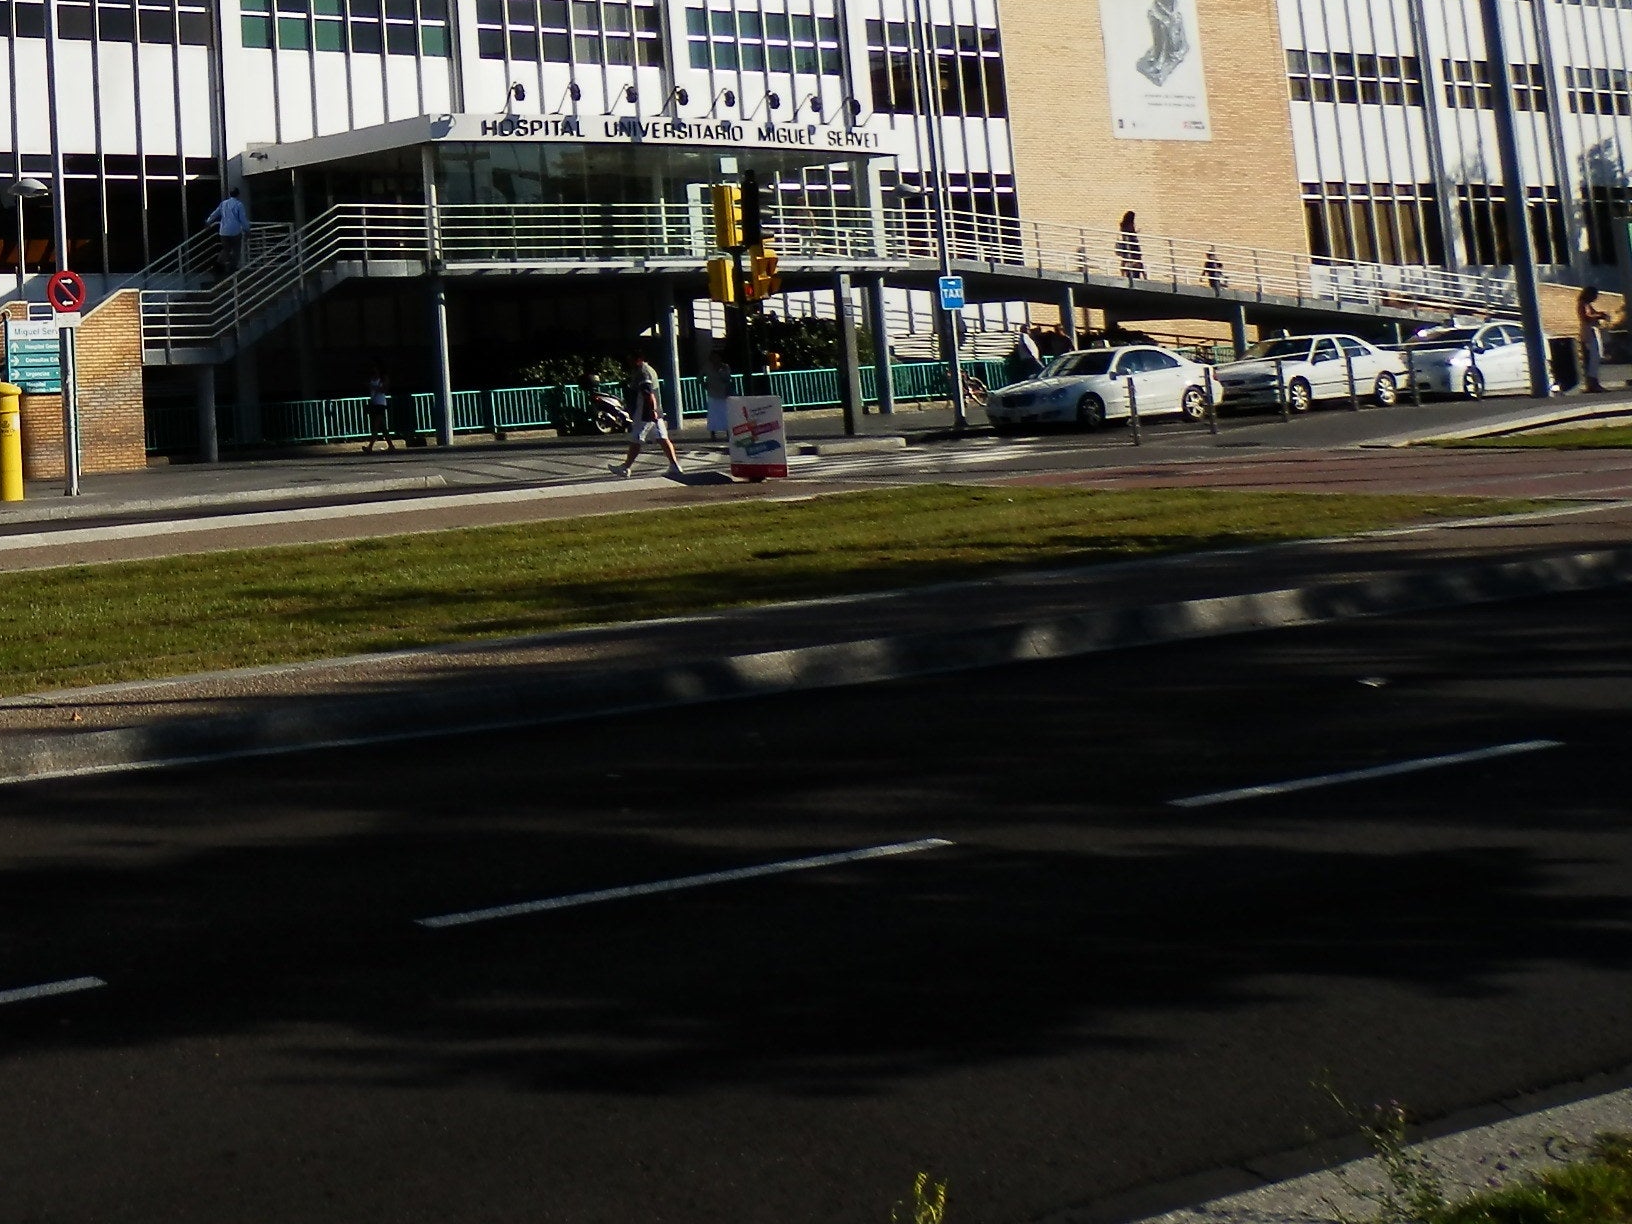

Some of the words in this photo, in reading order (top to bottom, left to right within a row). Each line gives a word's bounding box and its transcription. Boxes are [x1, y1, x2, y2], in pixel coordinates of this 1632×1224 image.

[480, 118, 586, 138] HOSPITAL
[604, 120, 744, 142] UNIVERSITARIO
[757, 125, 816, 145] MIGUEL
[941, 288, 963, 298] TAXI
[14, 328, 40, 336] Miguel
[42, 327, 60, 335] Serv
